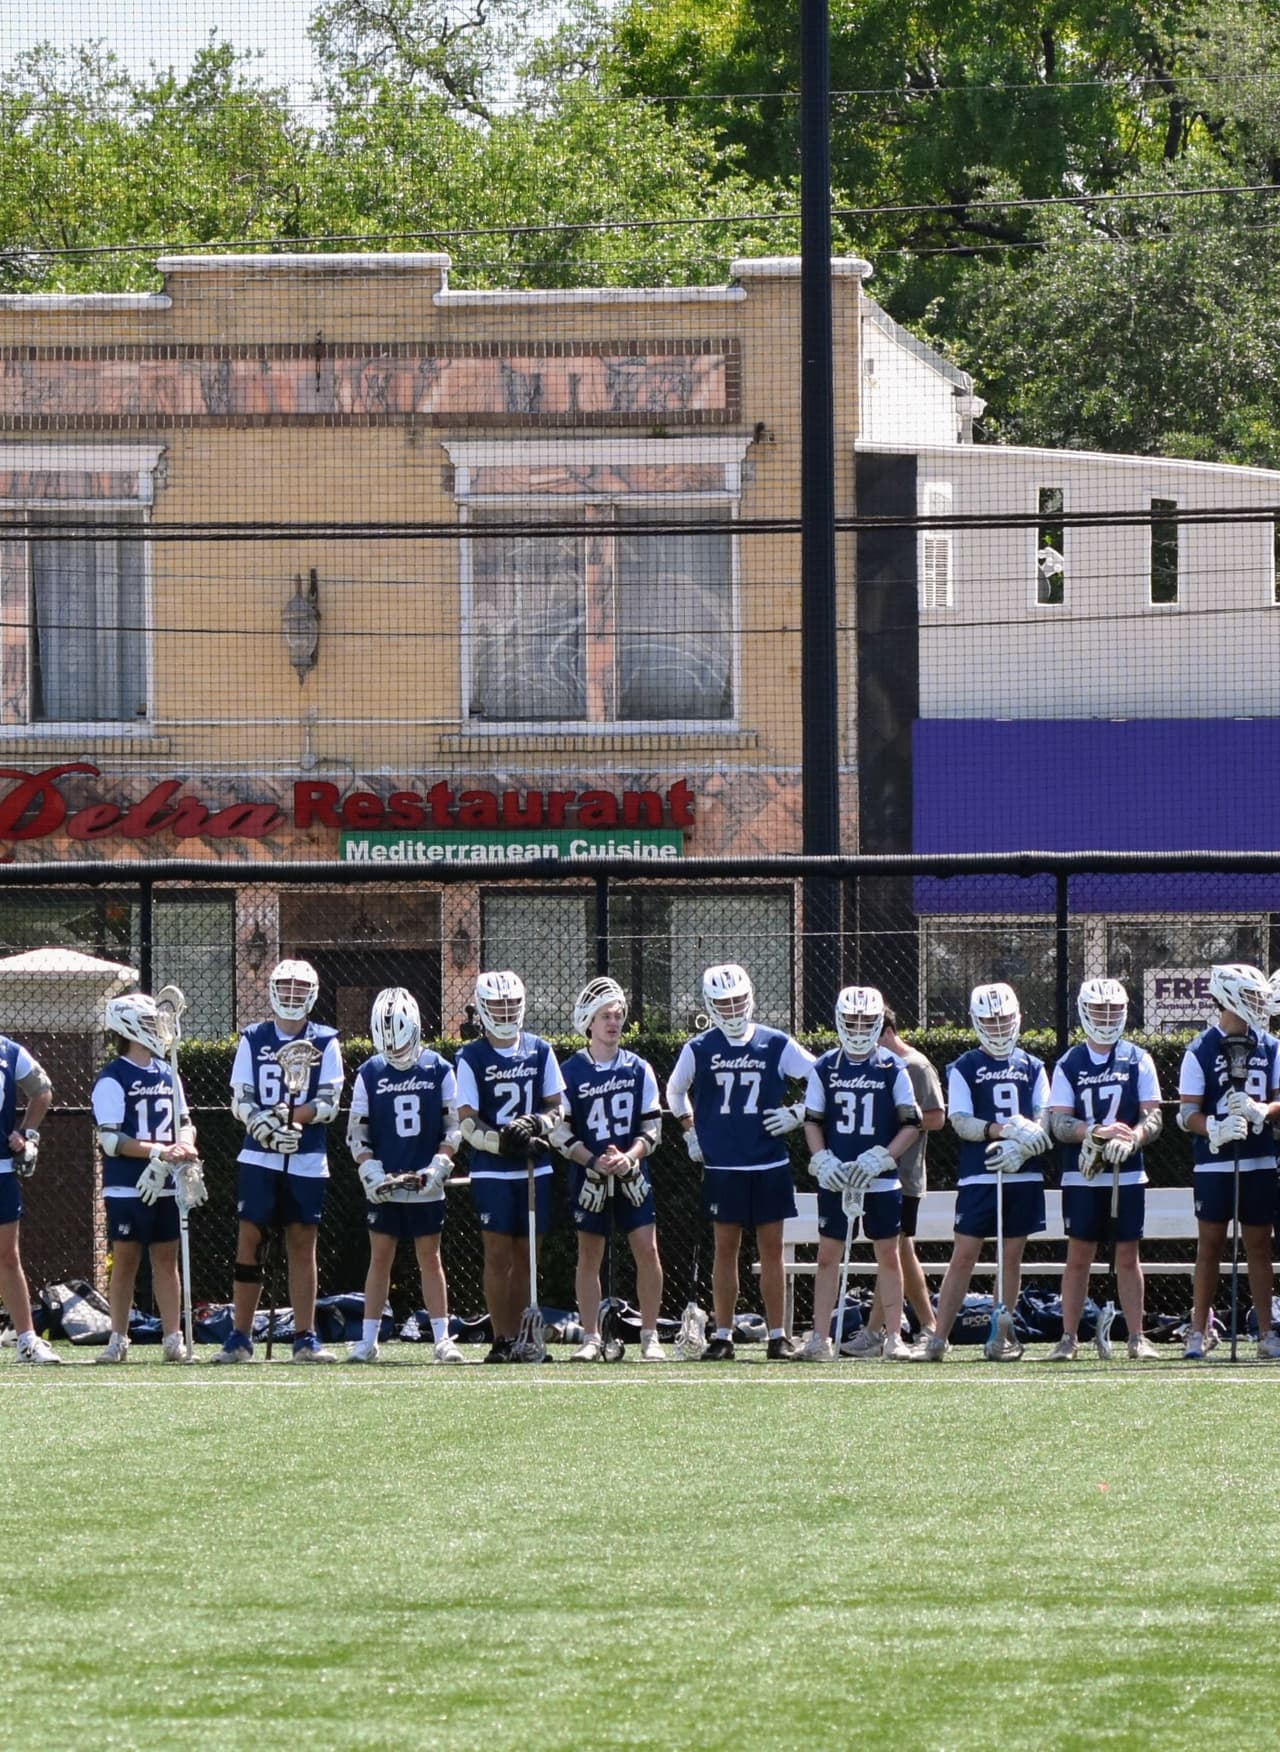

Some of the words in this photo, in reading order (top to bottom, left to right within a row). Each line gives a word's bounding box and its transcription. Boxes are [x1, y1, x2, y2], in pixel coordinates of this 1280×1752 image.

[294, 779, 696, 829] Restaurant
[345, 839, 559, 861] Mediterranean
[569, 839, 678, 861] Cuisine
[1155, 978, 1211, 999] FRE
[484, 1060, 538, 1082] Southern
[710, 1054, 766, 1071] Southern
[976, 1066, 1029, 1084] Southern
[1077, 1067, 1131, 1086] Southern
[376, 1076, 436, 1094] Southern
[578, 1077, 636, 1099] Southern
[715, 1072, 762, 1115] 77
[829, 1073, 886, 1090] Southern
[393, 1094, 421, 1138] 8
[494, 1080, 534, 1125] 21
[586, 1092, 634, 1142] 49
[834, 1092, 875, 1136] 31
[993, 1083, 1021, 1124] 9
[1081, 1084, 1124, 1127] 17
[135, 1098, 173, 1142] 12
